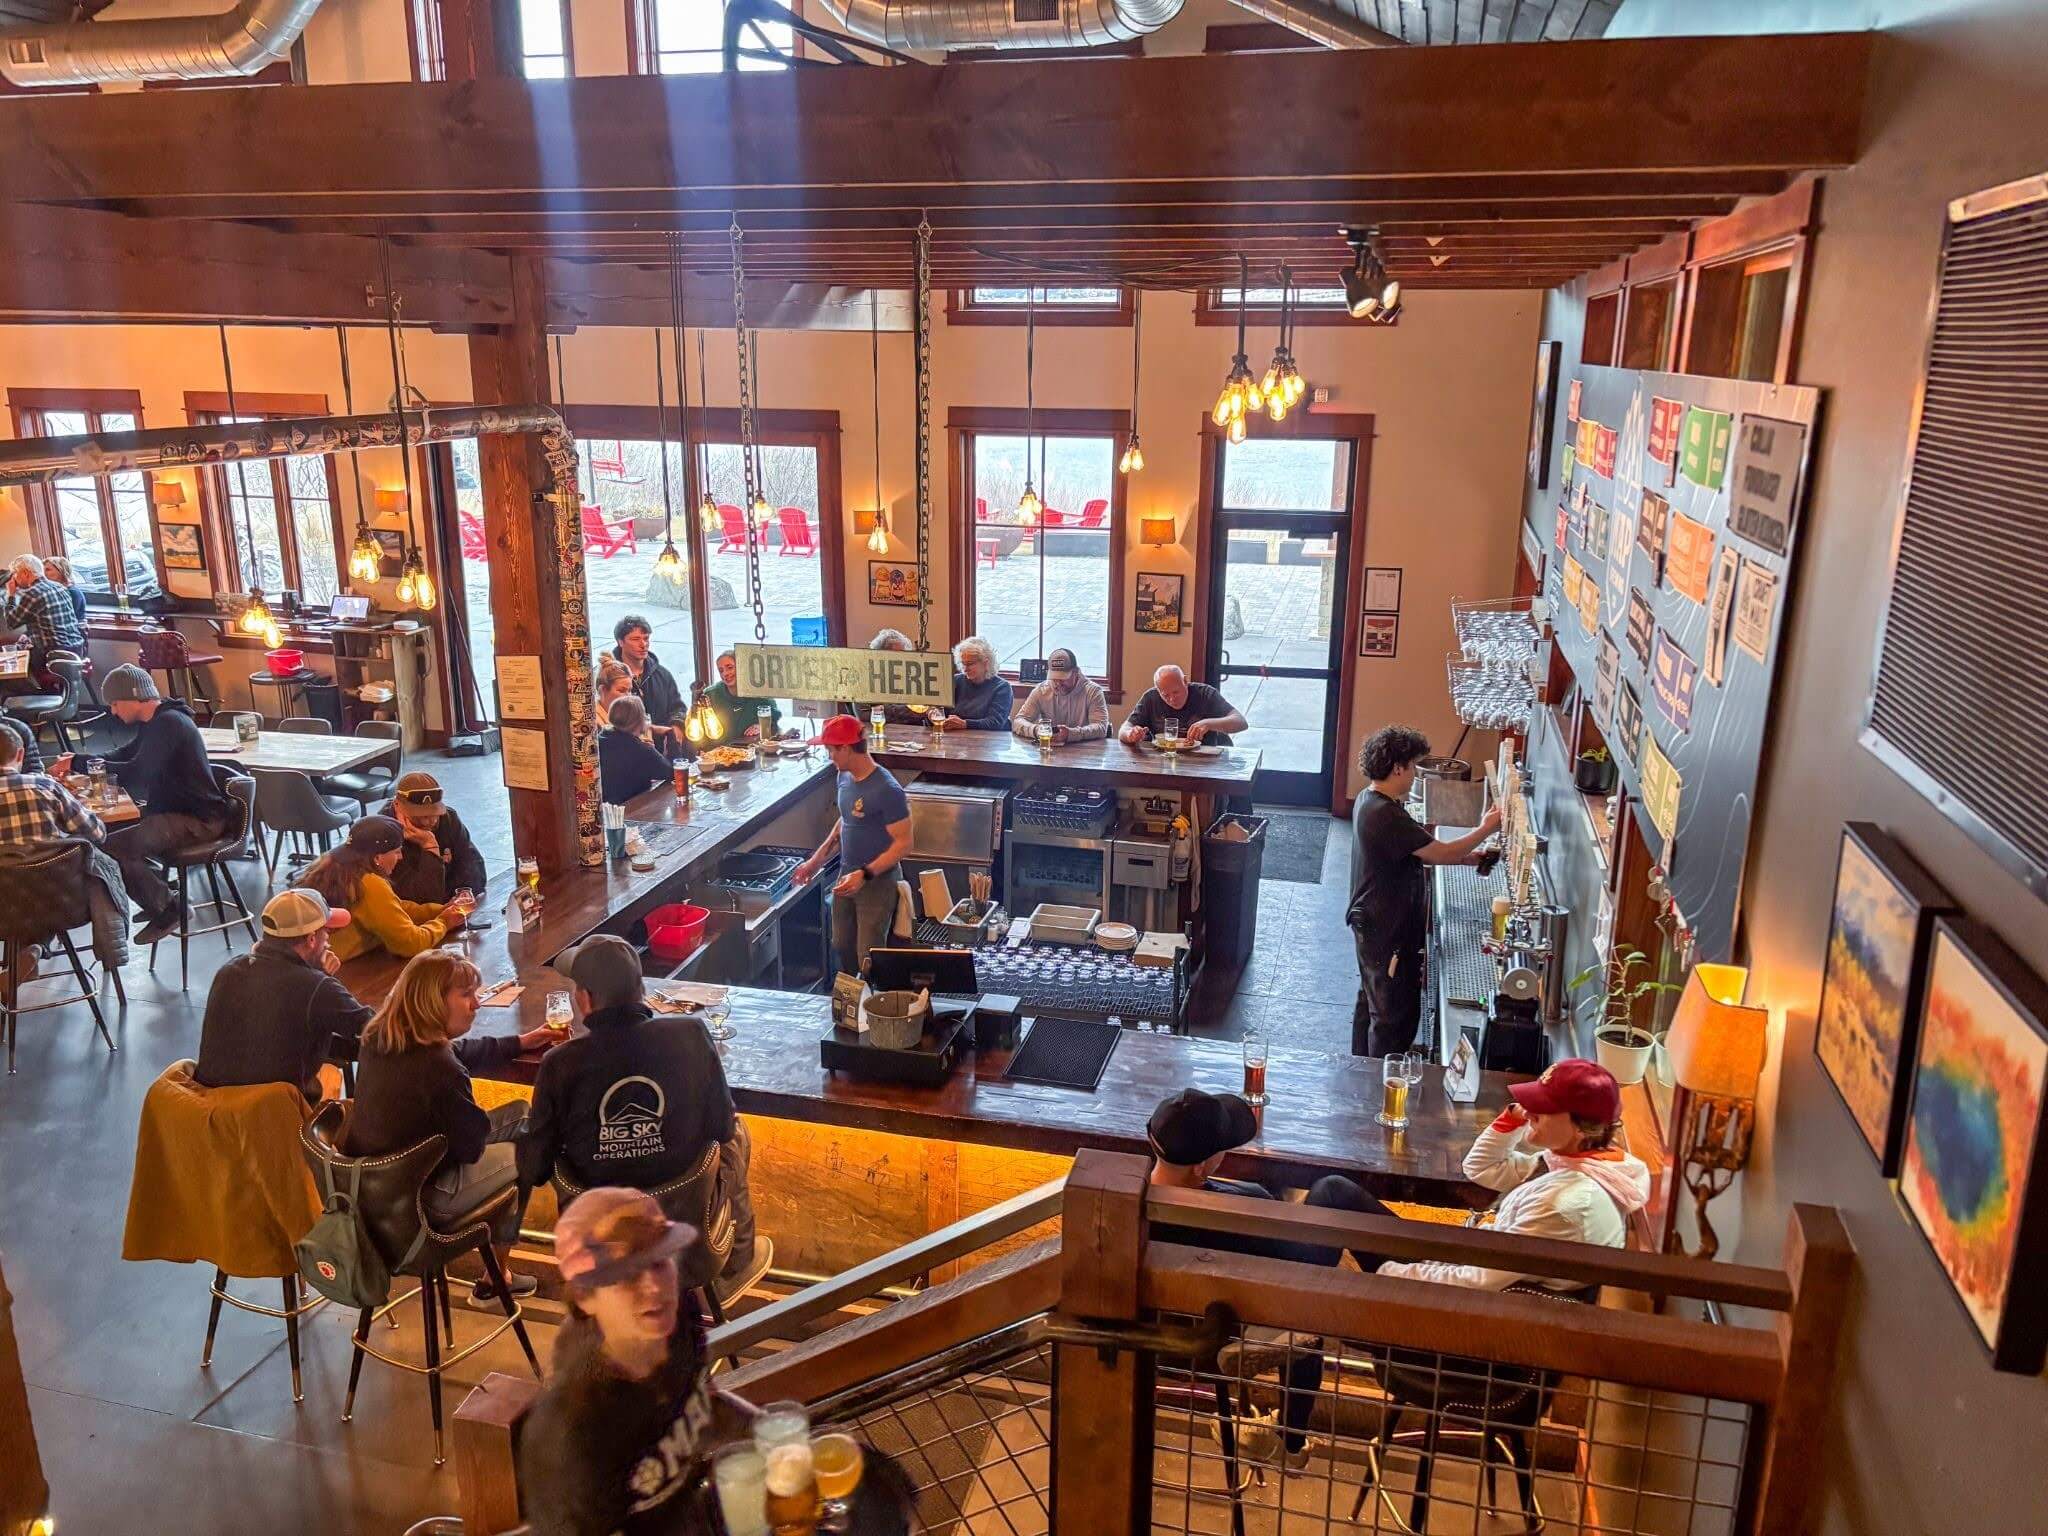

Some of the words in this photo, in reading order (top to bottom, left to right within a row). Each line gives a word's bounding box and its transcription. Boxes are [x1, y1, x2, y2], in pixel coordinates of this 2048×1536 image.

[868, 658, 940, 697] HERE
[599, 1126, 628, 1141] BIG
[631, 1121, 663, 1138] SKY
[592, 1144, 666, 1161] OPERATIONS
[599, 1136, 662, 1153] MOUNTAIN
